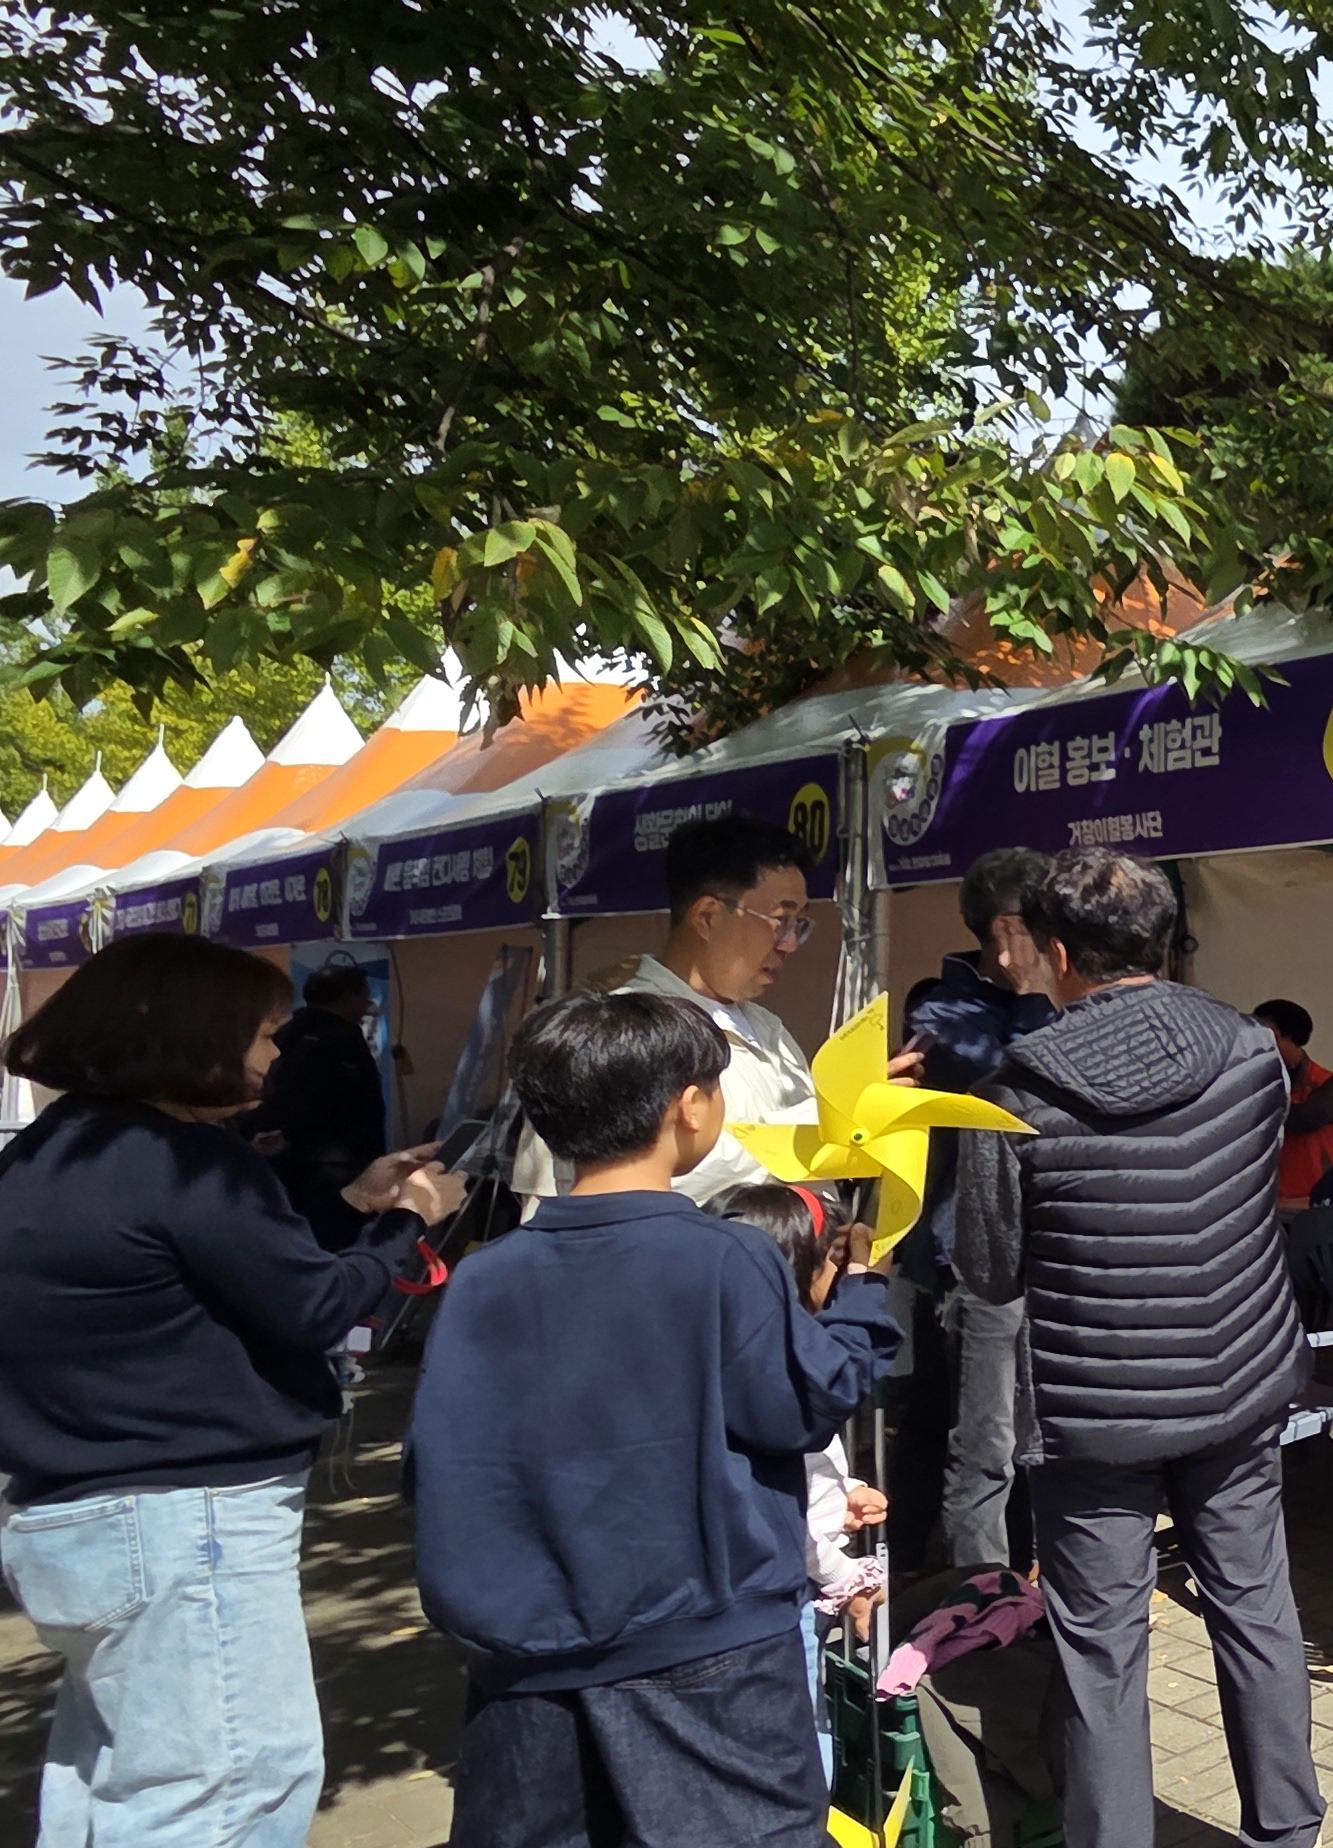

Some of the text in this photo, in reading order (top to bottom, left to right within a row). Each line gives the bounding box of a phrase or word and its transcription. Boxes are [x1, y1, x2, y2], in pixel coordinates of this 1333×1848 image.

[1014, 740, 1060, 793] 이혈
[1066, 731, 1116, 787] 홍보
[1138, 713, 1222, 773] 체험관
[793, 800, 825, 851] 80
[508, 847, 527, 892] 79
